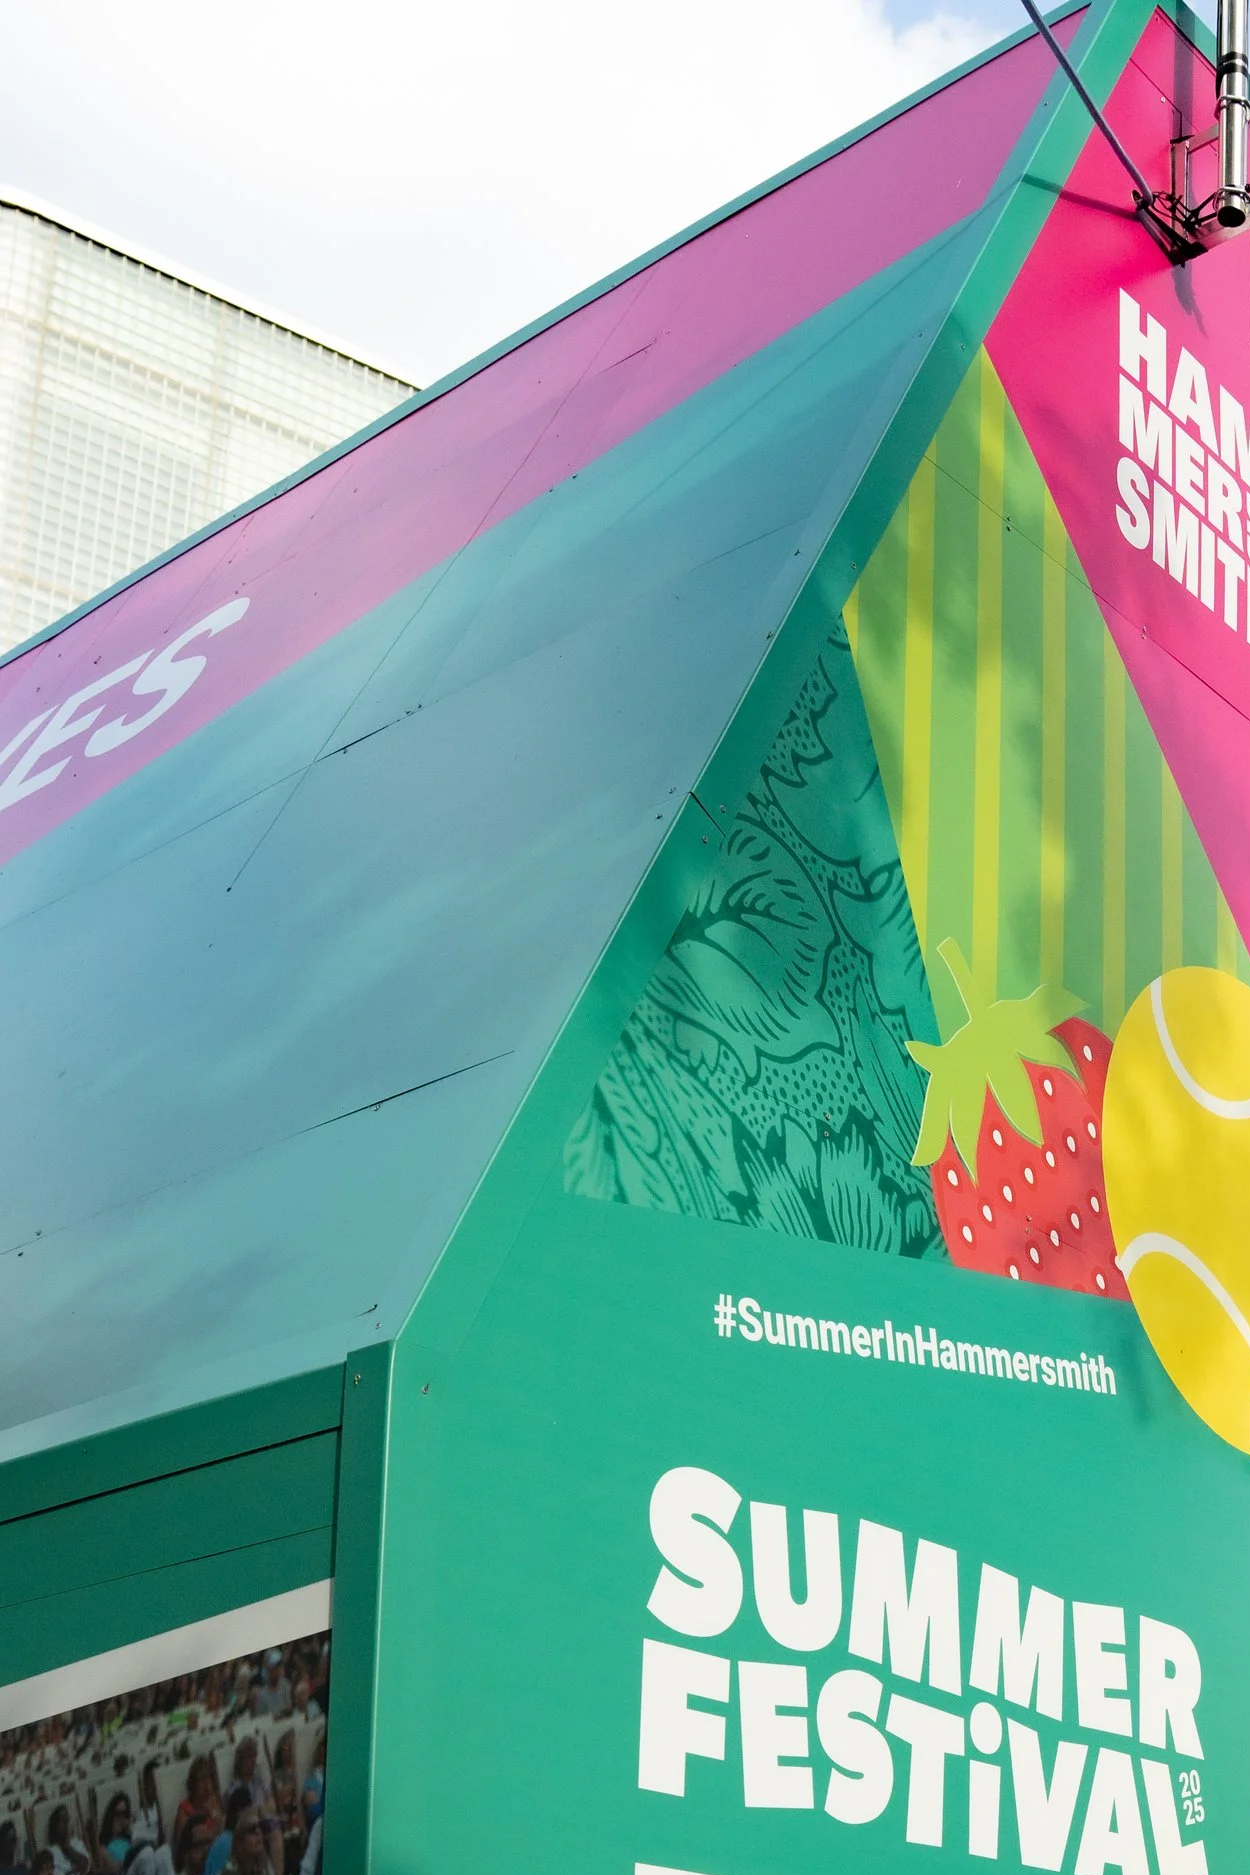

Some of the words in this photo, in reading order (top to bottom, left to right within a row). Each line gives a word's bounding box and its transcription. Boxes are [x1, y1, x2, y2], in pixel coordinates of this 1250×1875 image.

[1118, 372, 1244, 552] MER
[713, 1293, 1117, 1396] #SummerInHammersmith
[645, 1465, 1205, 1762] SUMMER
[1177, 1769, 1201, 1798] 20
[1183, 1797, 1206, 1826] 25
